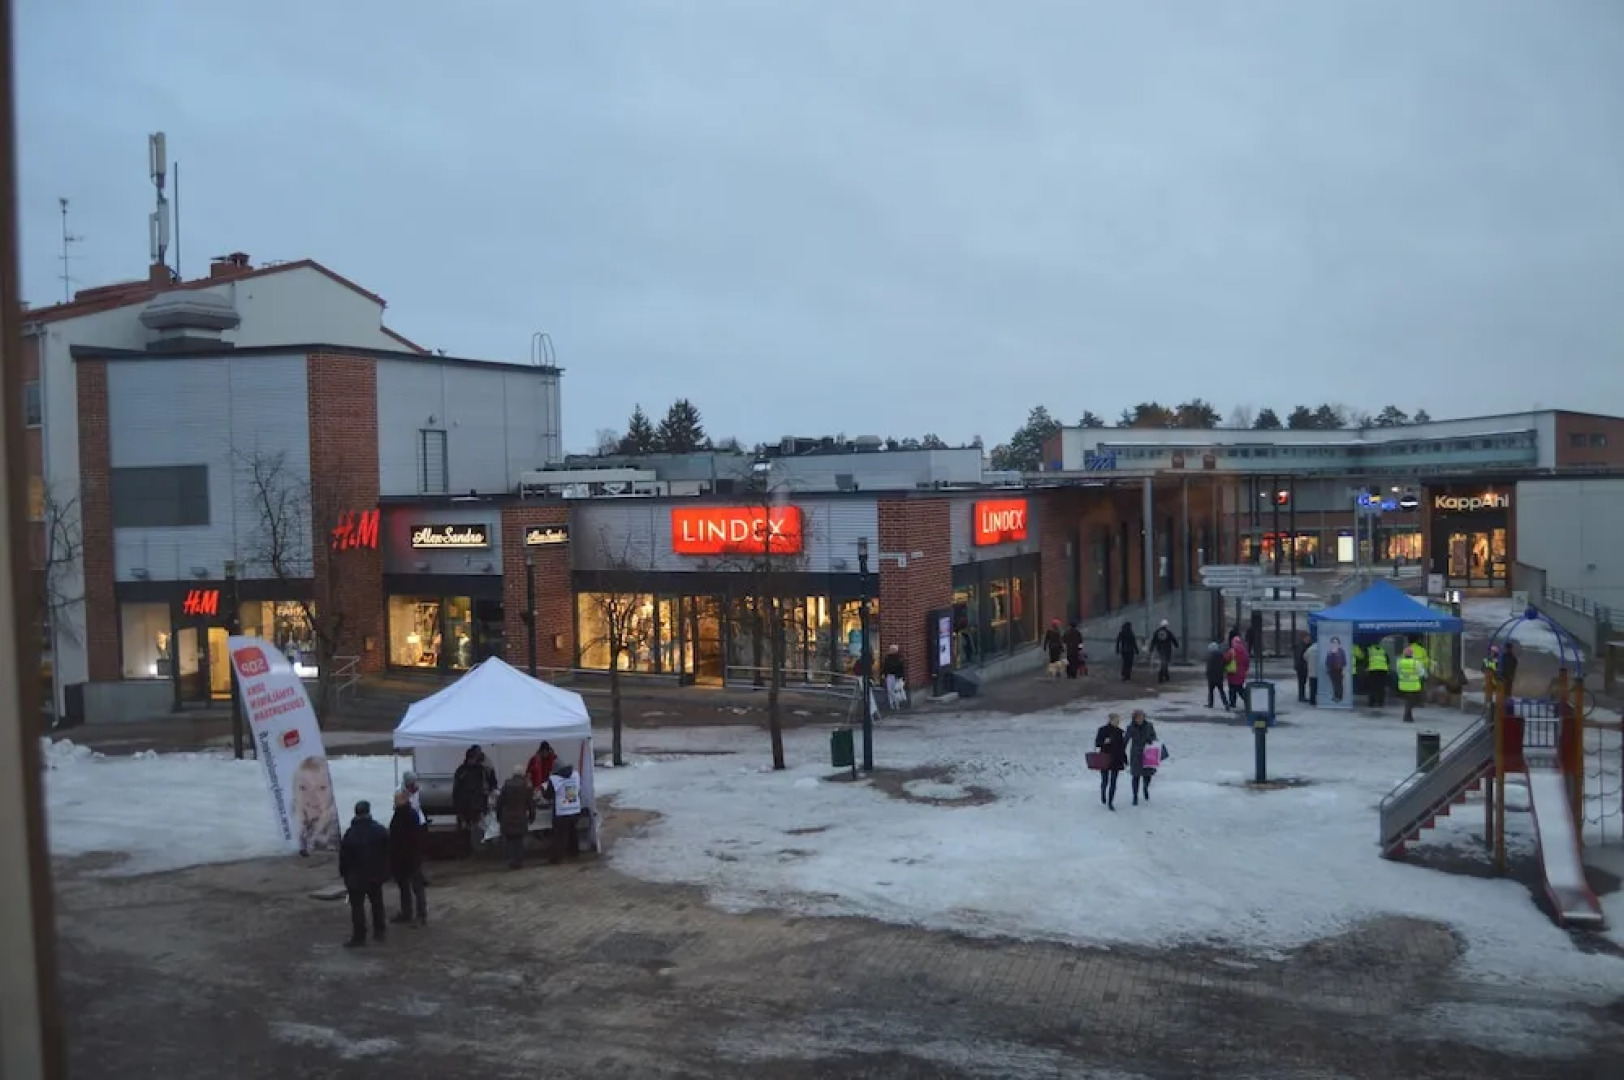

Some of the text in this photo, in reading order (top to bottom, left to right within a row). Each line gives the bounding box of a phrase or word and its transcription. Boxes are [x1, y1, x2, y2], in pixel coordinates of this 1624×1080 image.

[1434, 493, 1510, 511] KappAhl
[331, 508, 381, 551] H&M
[682, 517, 785, 544] LINDEX
[982, 509, 1024, 534] LINDEX
[182, 589, 220, 616] H&M
